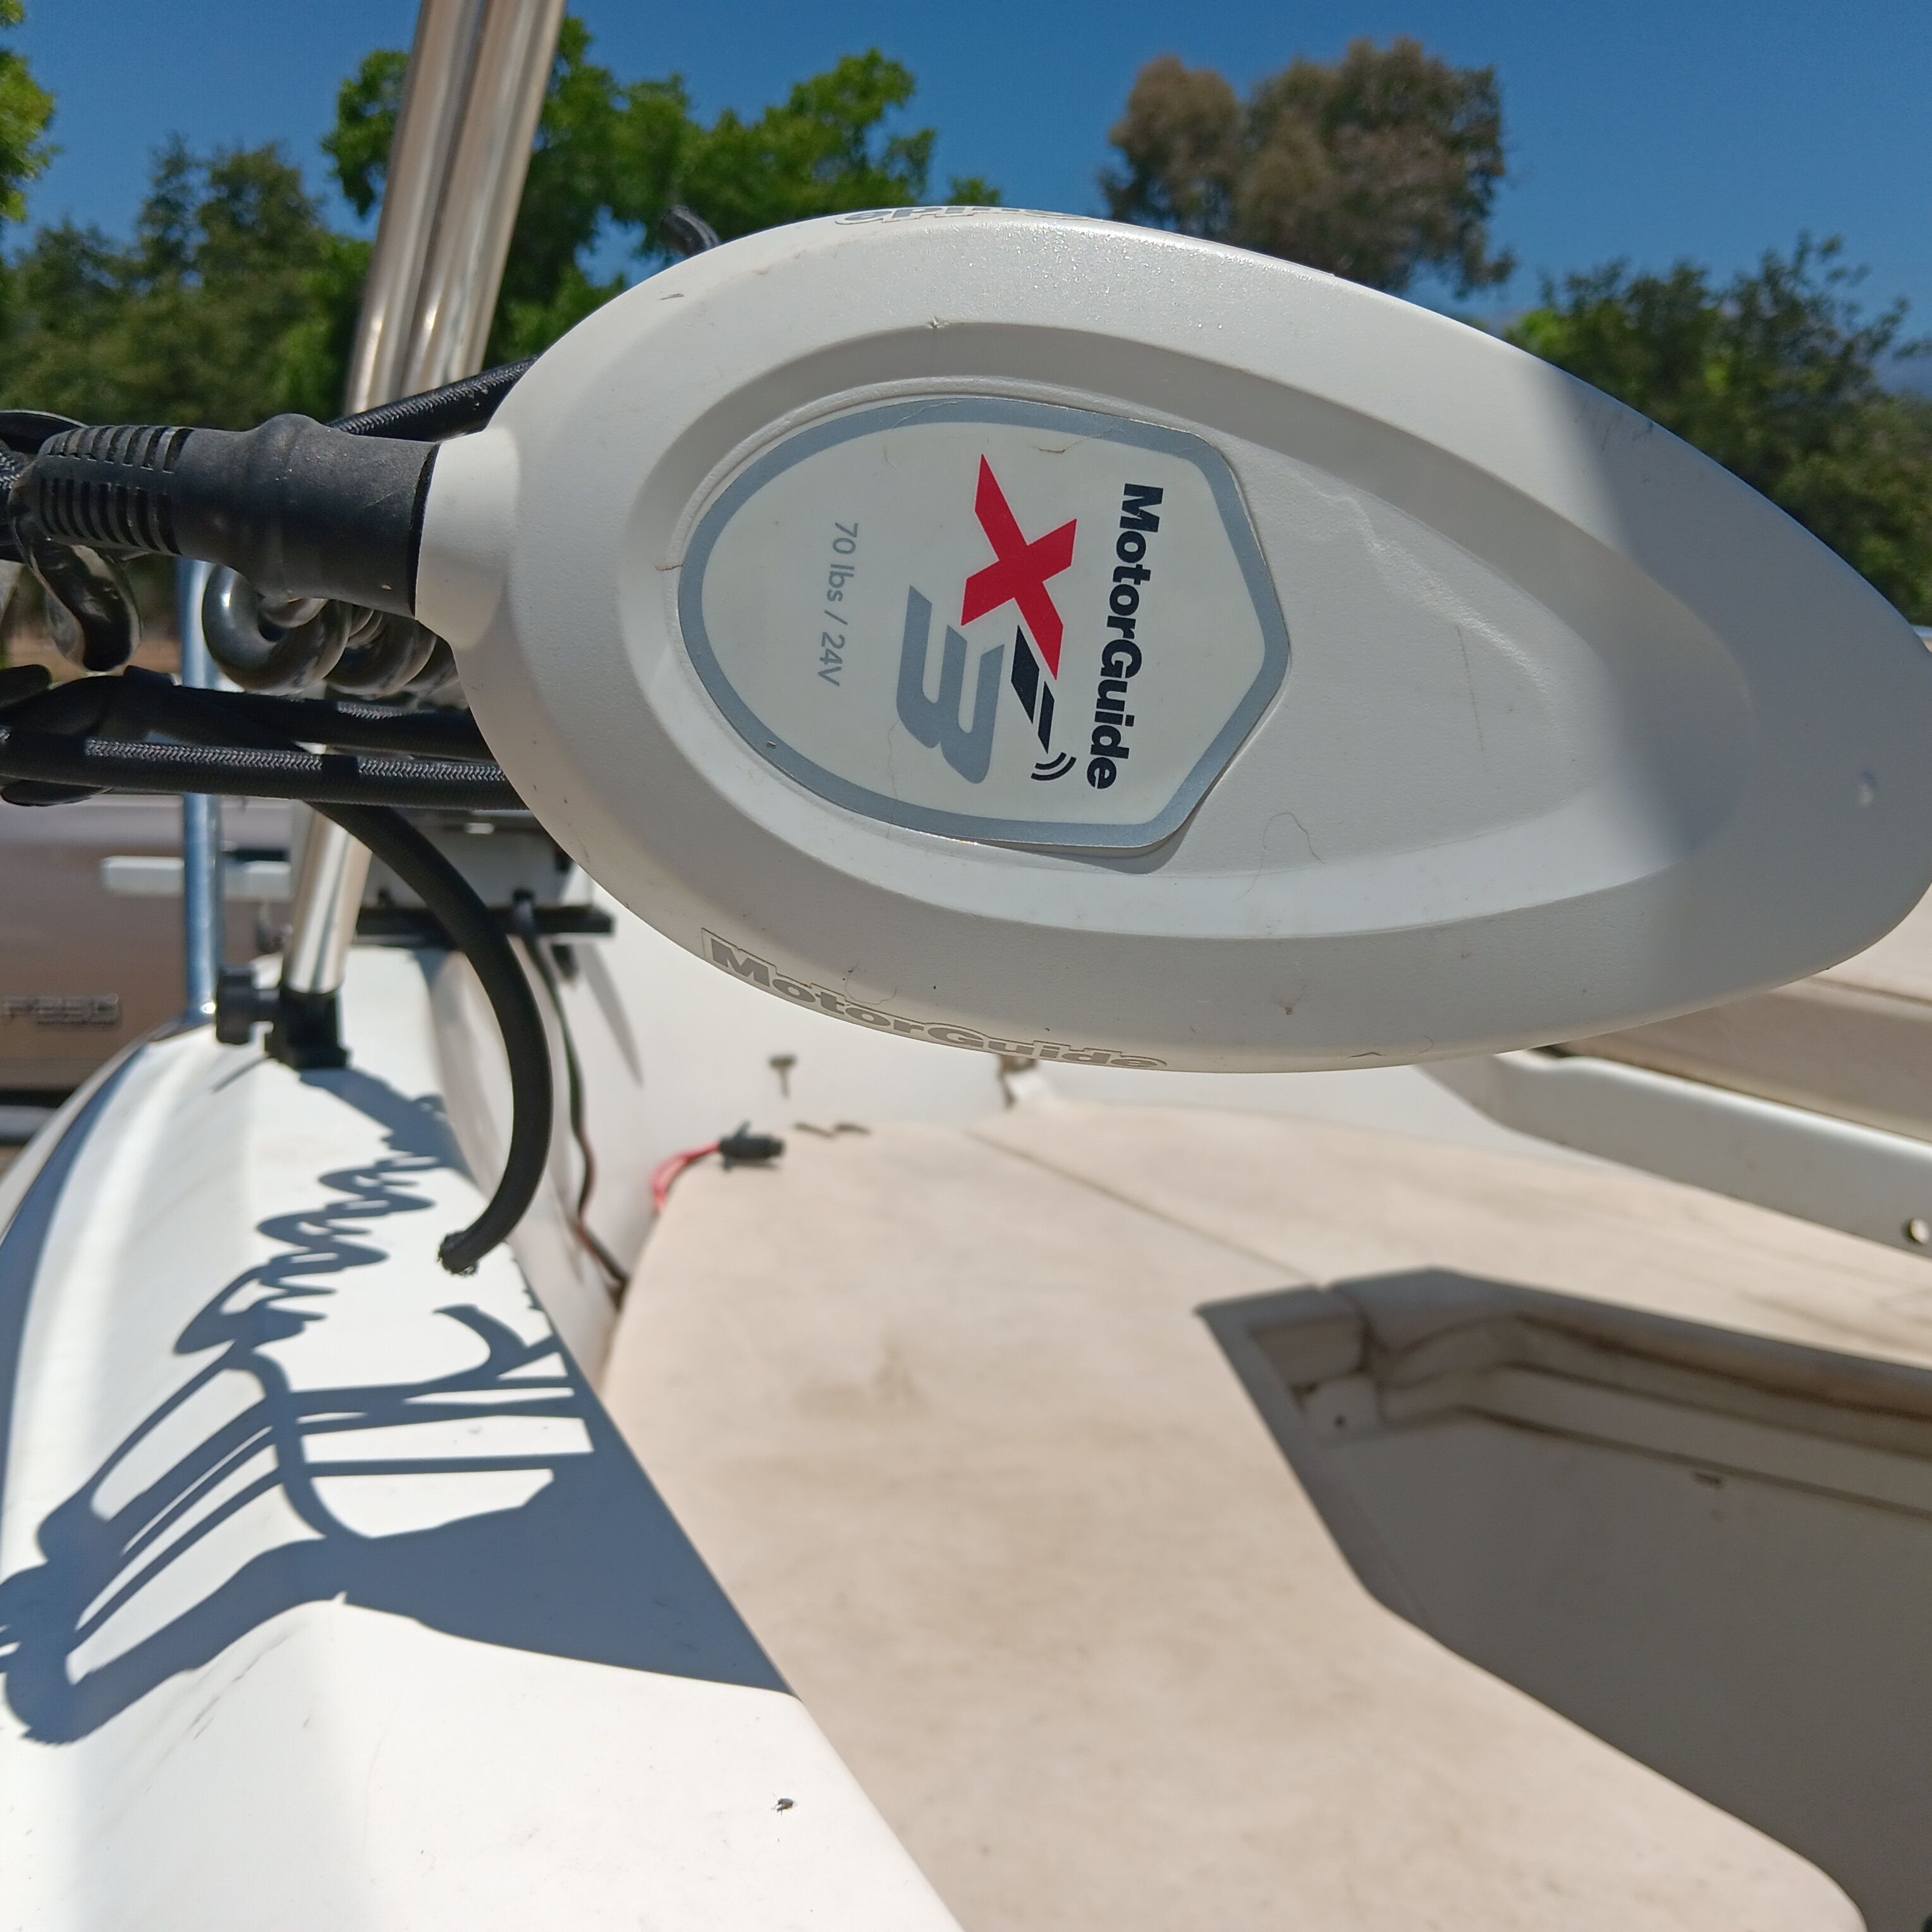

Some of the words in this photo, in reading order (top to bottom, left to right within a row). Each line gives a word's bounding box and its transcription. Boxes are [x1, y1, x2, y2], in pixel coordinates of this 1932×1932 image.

[831, 522, 859, 555] 70
[826, 563, 855, 603] lbs
[824, 609, 848, 625] /
[1086, 482, 1164, 790] MotorGuide
[817, 631, 846, 687] 24V
[710, 938, 1158, 1067] MotorGuide
